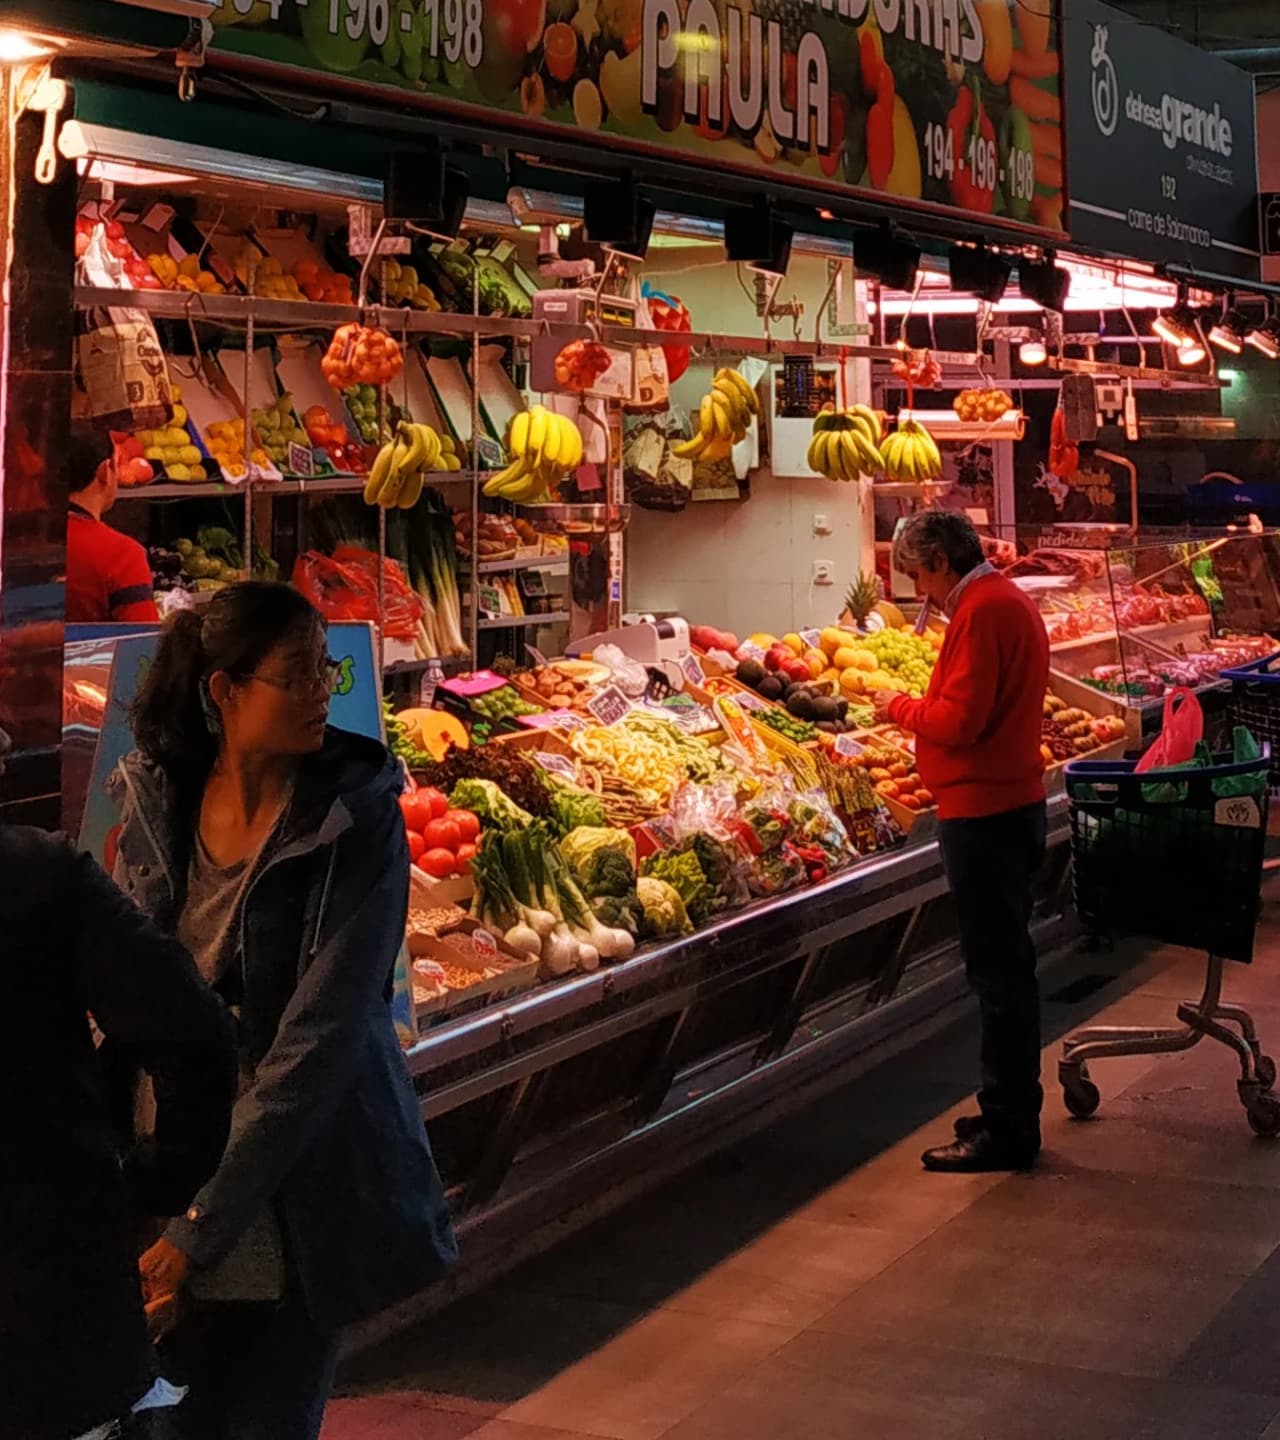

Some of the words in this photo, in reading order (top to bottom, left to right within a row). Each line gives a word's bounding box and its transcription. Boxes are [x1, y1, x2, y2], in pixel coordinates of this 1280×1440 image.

[924, 121, 954, 181] 194
[968, 135, 996, 192] 196
[1009, 146, 1034, 201] 198
